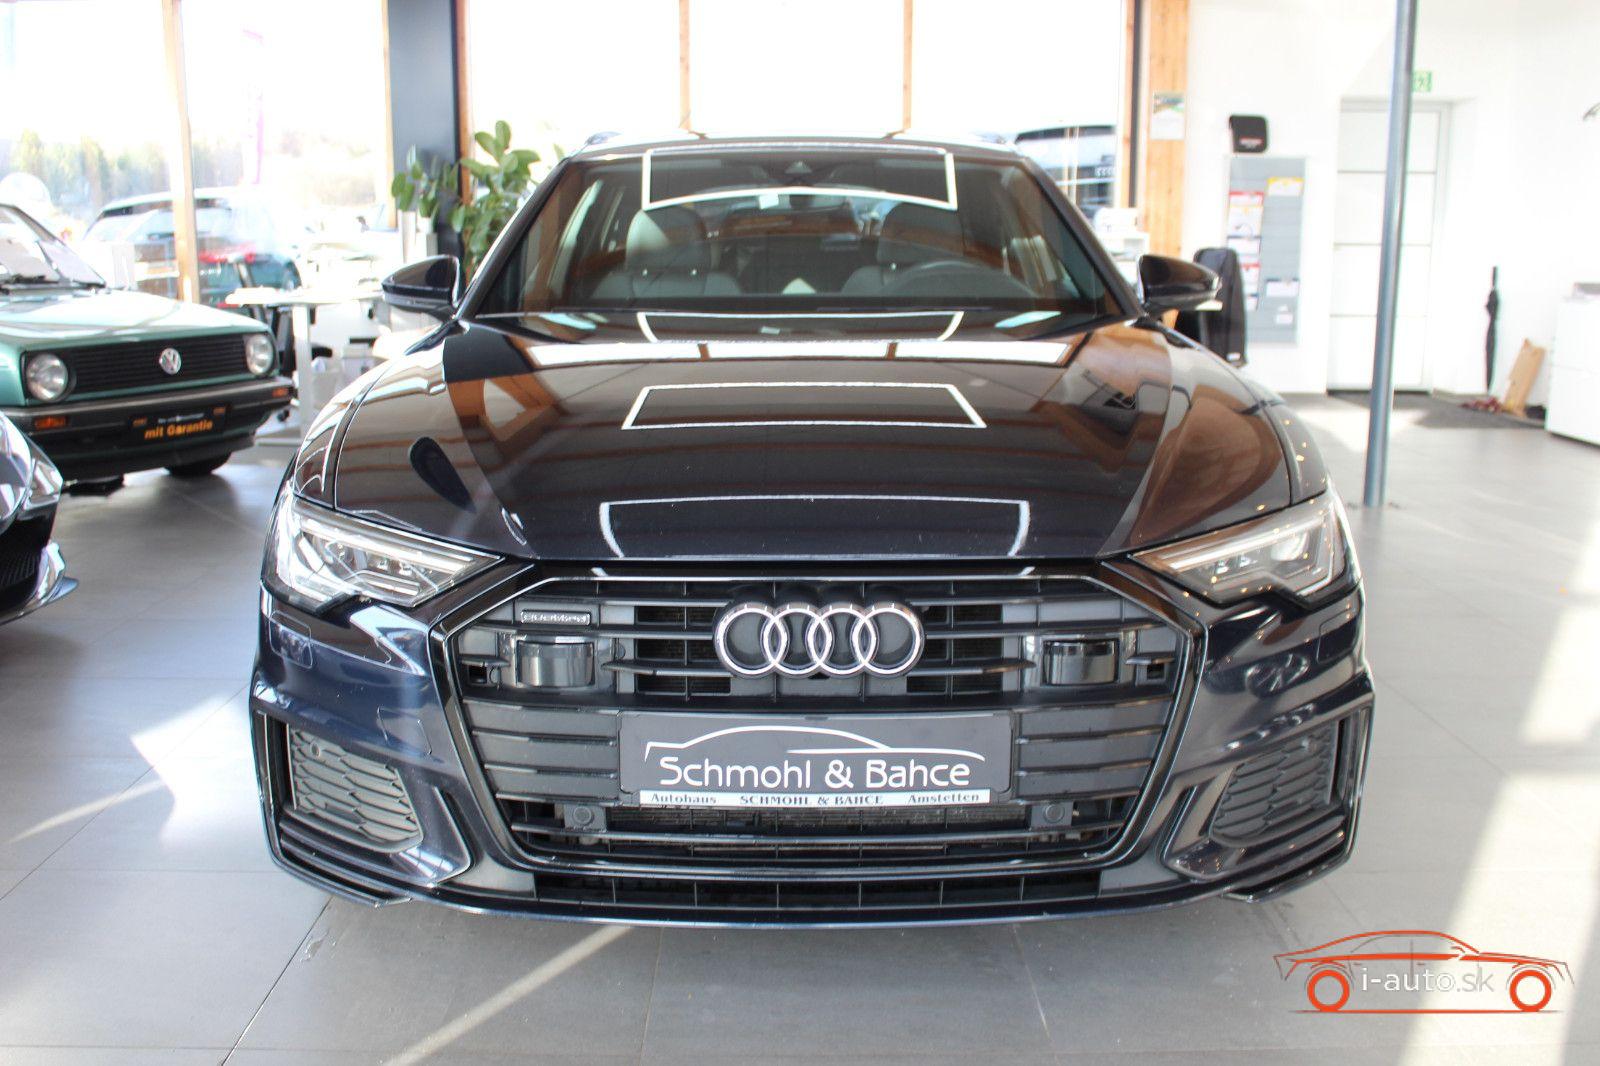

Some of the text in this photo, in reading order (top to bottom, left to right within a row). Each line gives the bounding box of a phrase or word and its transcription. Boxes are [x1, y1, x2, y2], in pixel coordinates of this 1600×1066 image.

[144, 419, 213, 439] mit Garantie
[659, 756, 971, 789] Schmohl & Bahce
[651, 792, 980, 806] Autohaus SCHMOHL & BAHCE Amstetten
